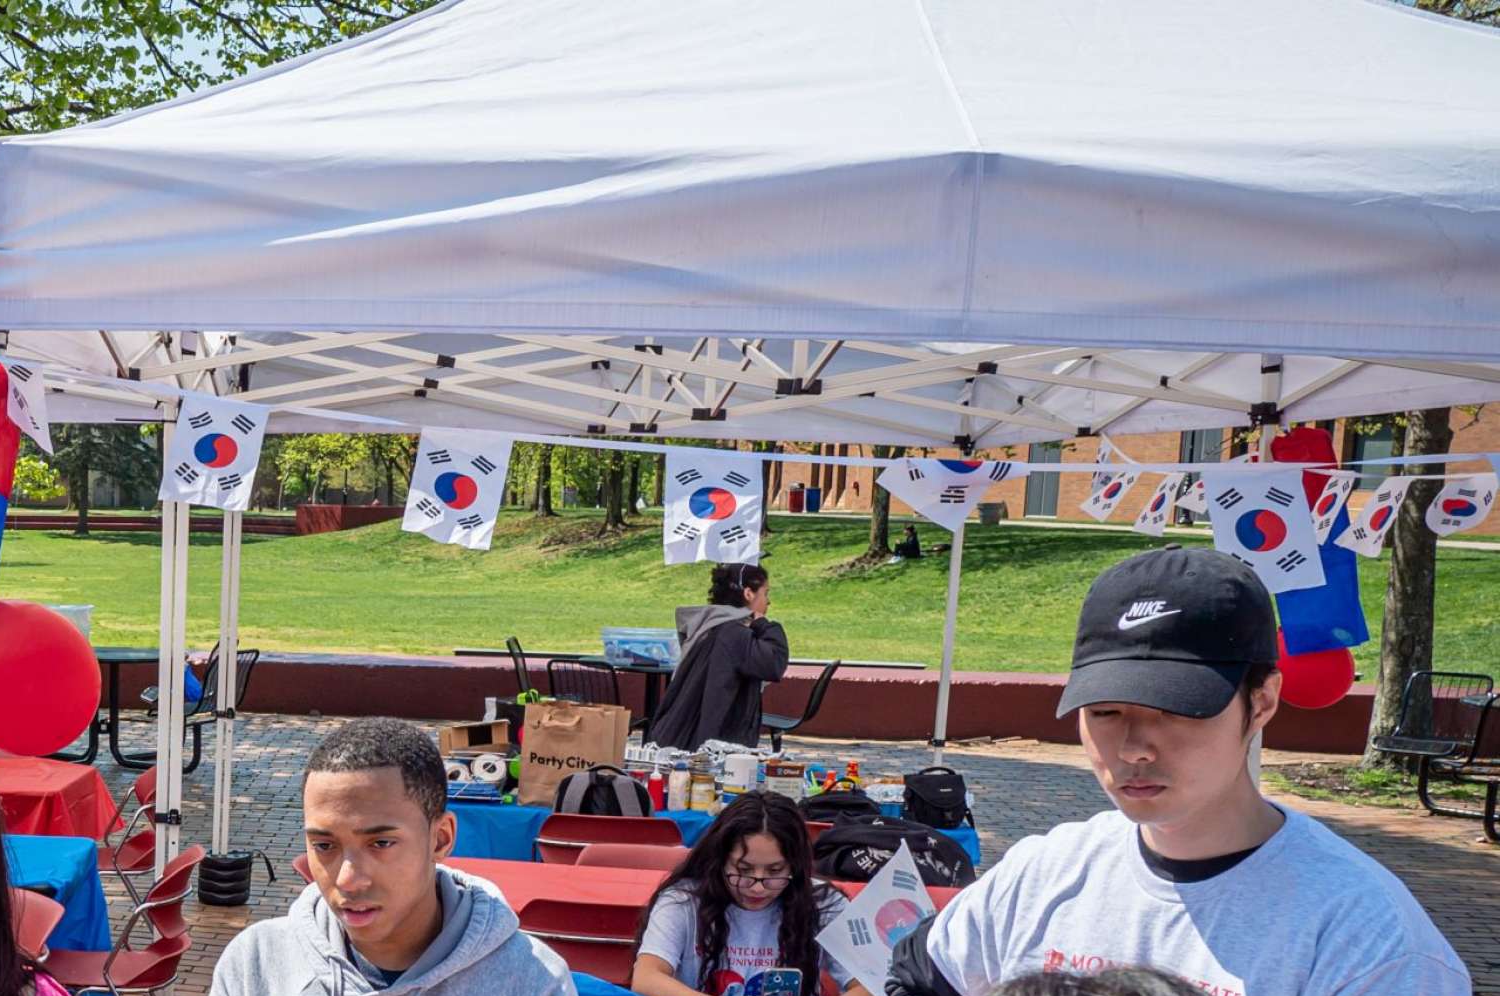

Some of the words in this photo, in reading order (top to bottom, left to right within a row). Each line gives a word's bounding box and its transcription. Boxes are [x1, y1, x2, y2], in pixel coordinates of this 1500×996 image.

[1128, 600, 1167, 617] NIKE
[530, 752, 564, 770] Party
[566, 756, 596, 769] City
[725, 945, 773, 957] NTCLAIR
